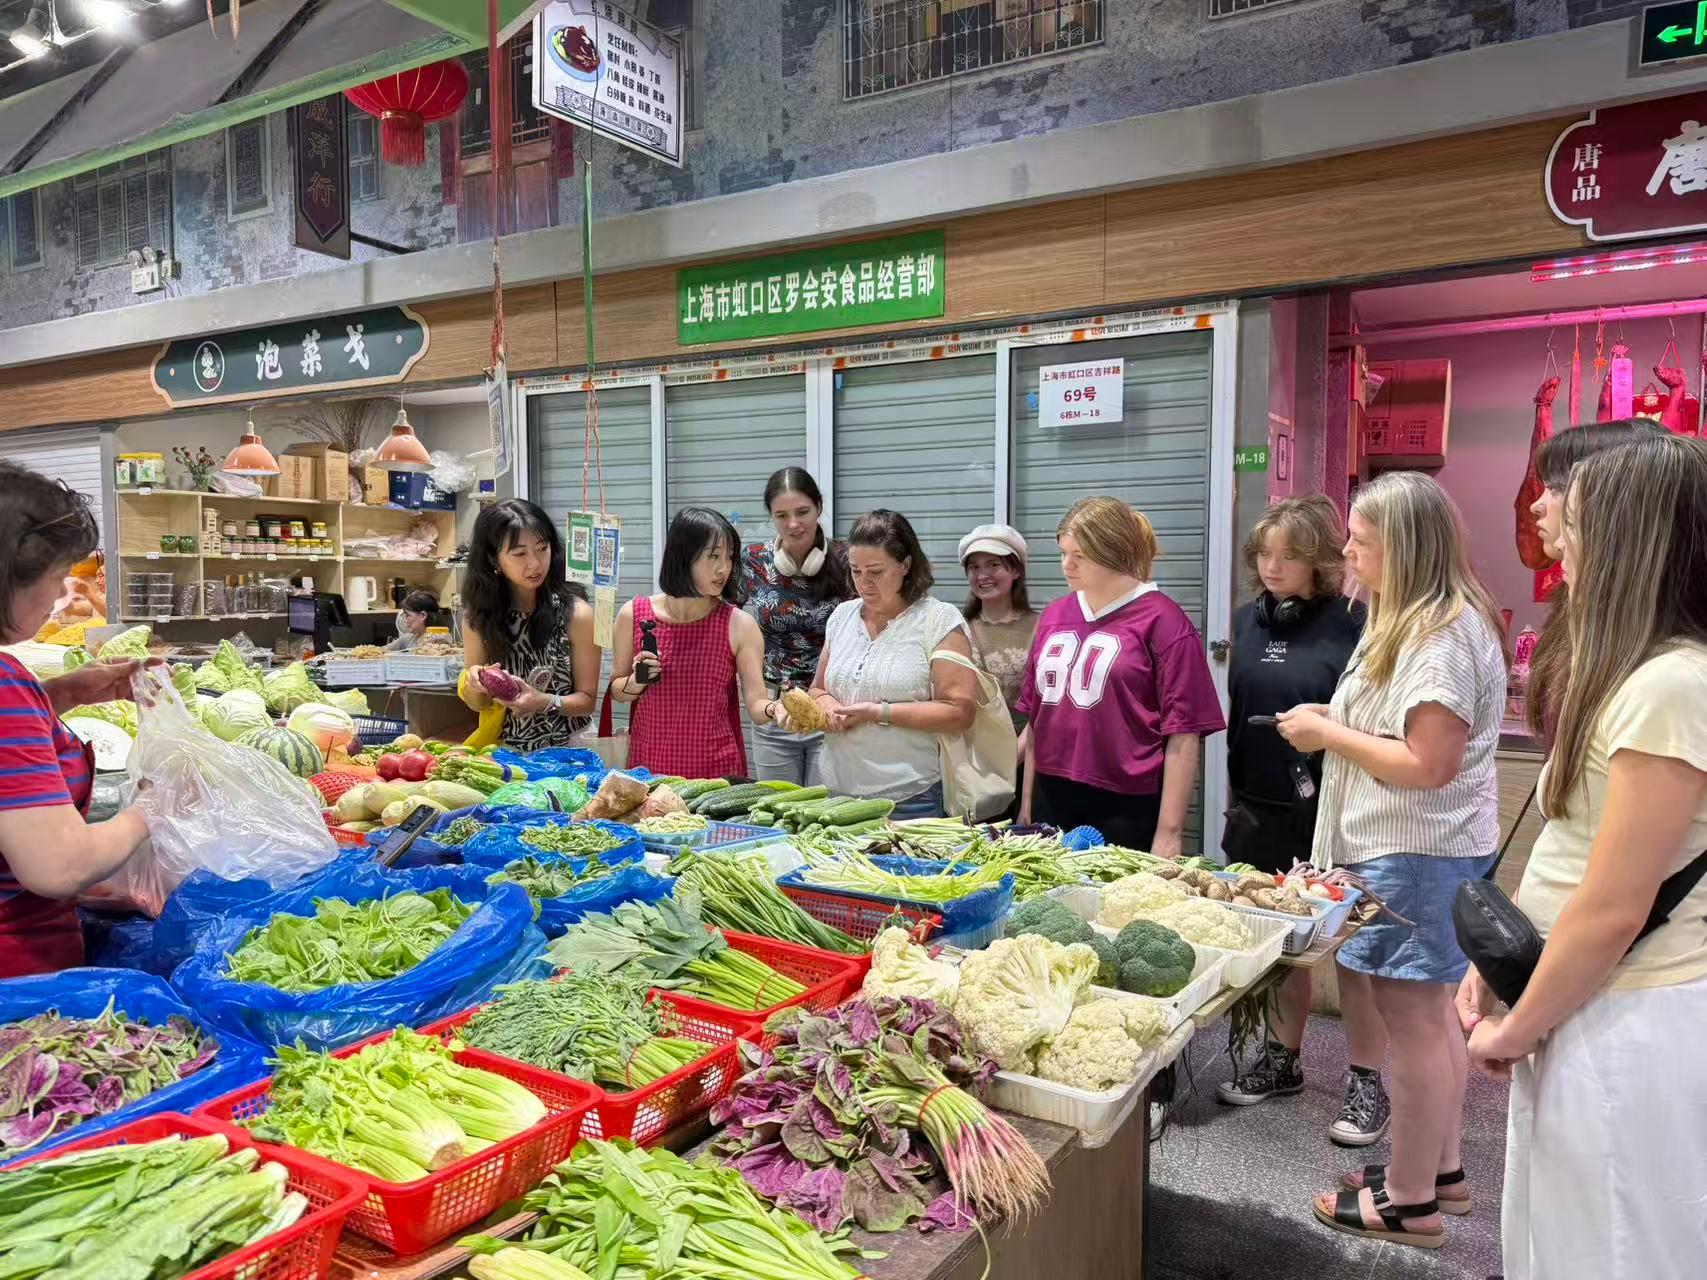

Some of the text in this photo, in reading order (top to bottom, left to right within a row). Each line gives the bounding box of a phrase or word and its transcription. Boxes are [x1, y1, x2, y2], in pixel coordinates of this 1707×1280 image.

[1571, 143, 1603, 203] 唐品
[683, 252, 936, 324] 上海市虹口区罗会安食品经营部
[1042, 365, 1121, 382] 上海市虹口区吉祥路
[1063, 386, 1097, 403] 69号
[1235, 452, 1266, 465] M-18
[1034, 630, 1122, 710] 80
